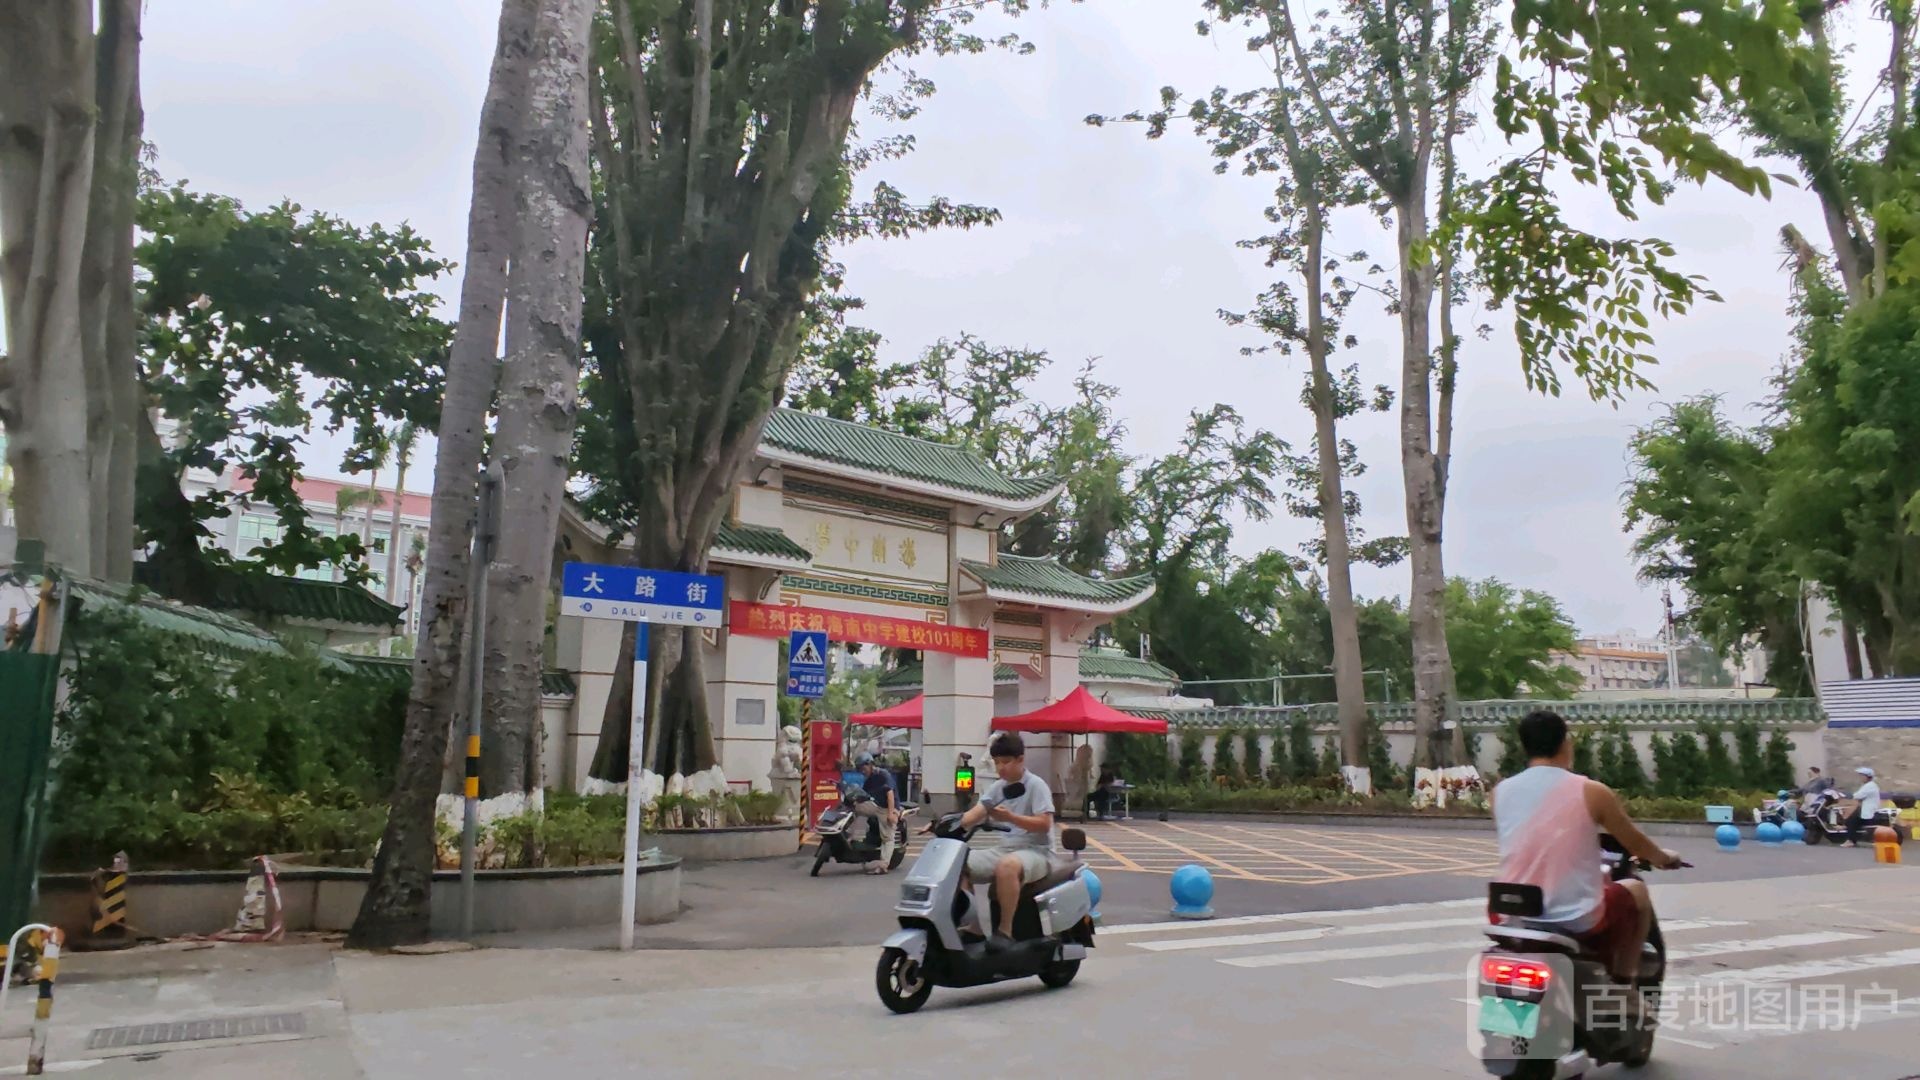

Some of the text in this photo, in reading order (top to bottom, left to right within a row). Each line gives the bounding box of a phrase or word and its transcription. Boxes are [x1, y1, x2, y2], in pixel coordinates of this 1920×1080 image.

[583, 572, 708, 603] 大路街
[611, 606, 684, 620] DALU JIE
